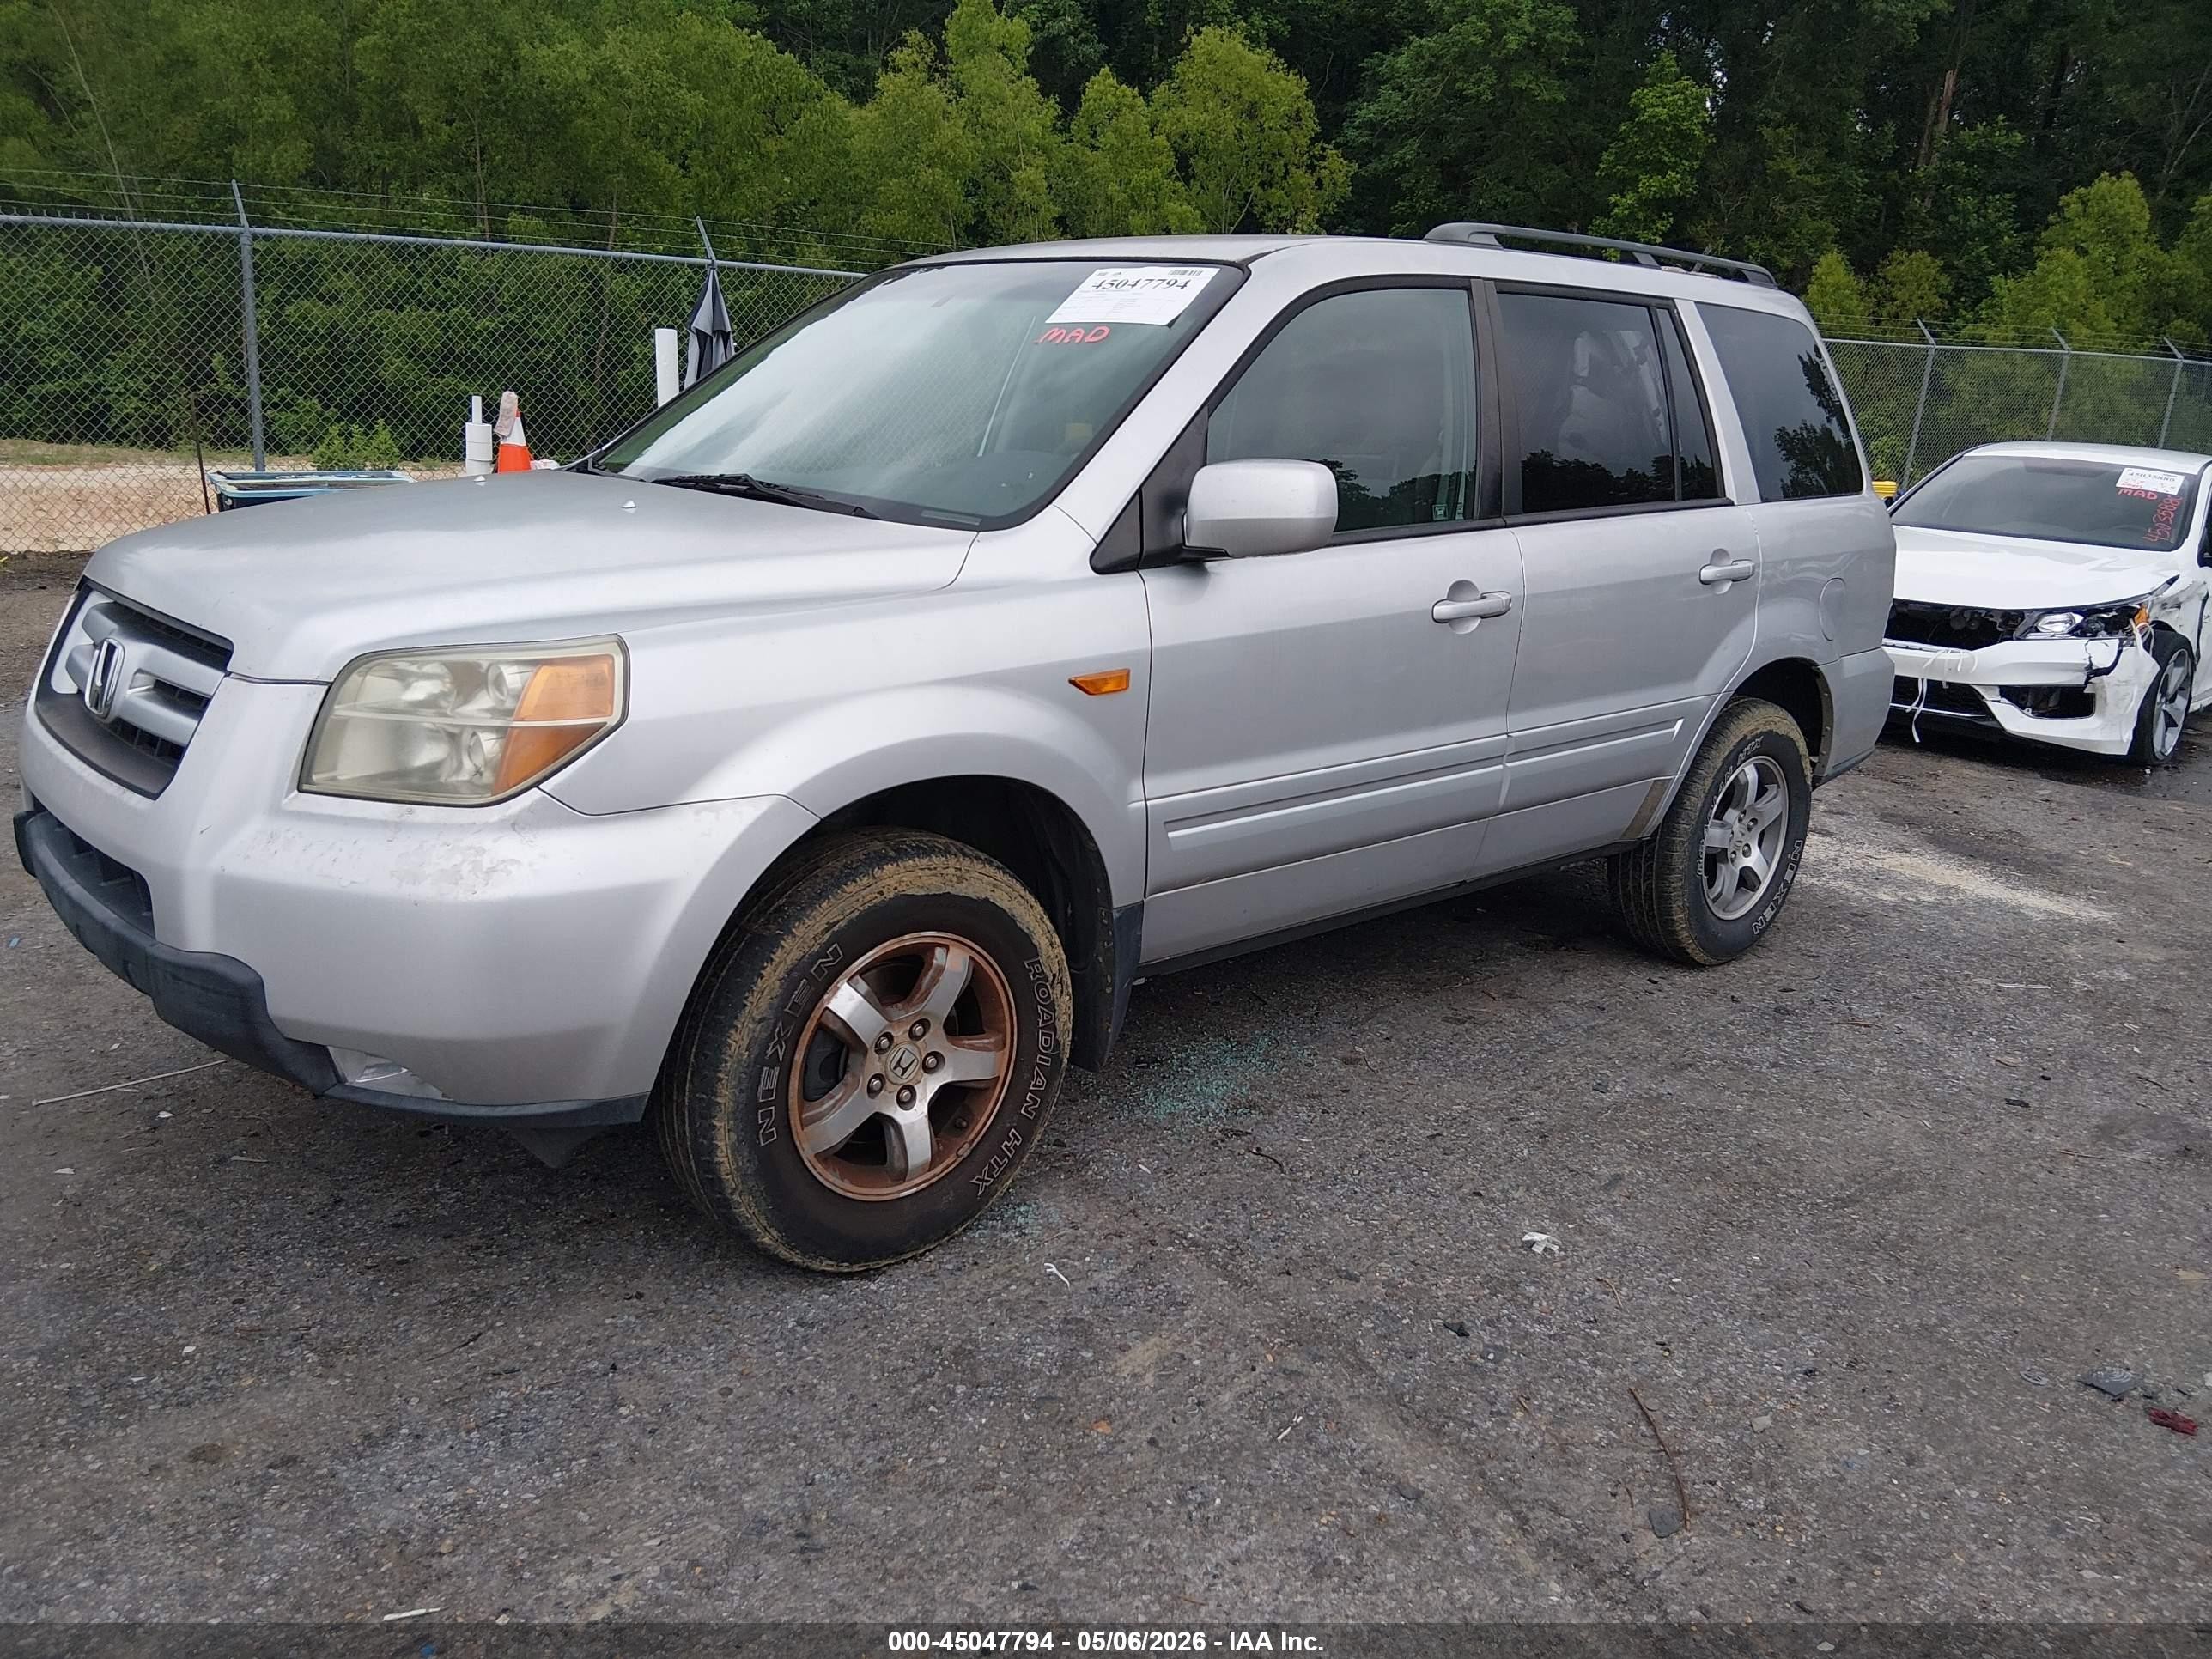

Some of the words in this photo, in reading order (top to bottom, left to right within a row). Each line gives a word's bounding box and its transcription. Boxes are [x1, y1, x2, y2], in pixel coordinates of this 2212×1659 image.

[1091, 278, 1192, 290] 45047794
[1035, 325, 1111, 344] MAD
[2118, 488, 2158, 500] MAD
[1752, 840, 1803, 935] NEXEN
[757, 943, 844, 1146] NEXEN
[1020, 957, 1055, 1121] ROADIAN
[970, 1127, 1023, 1196] HTX
